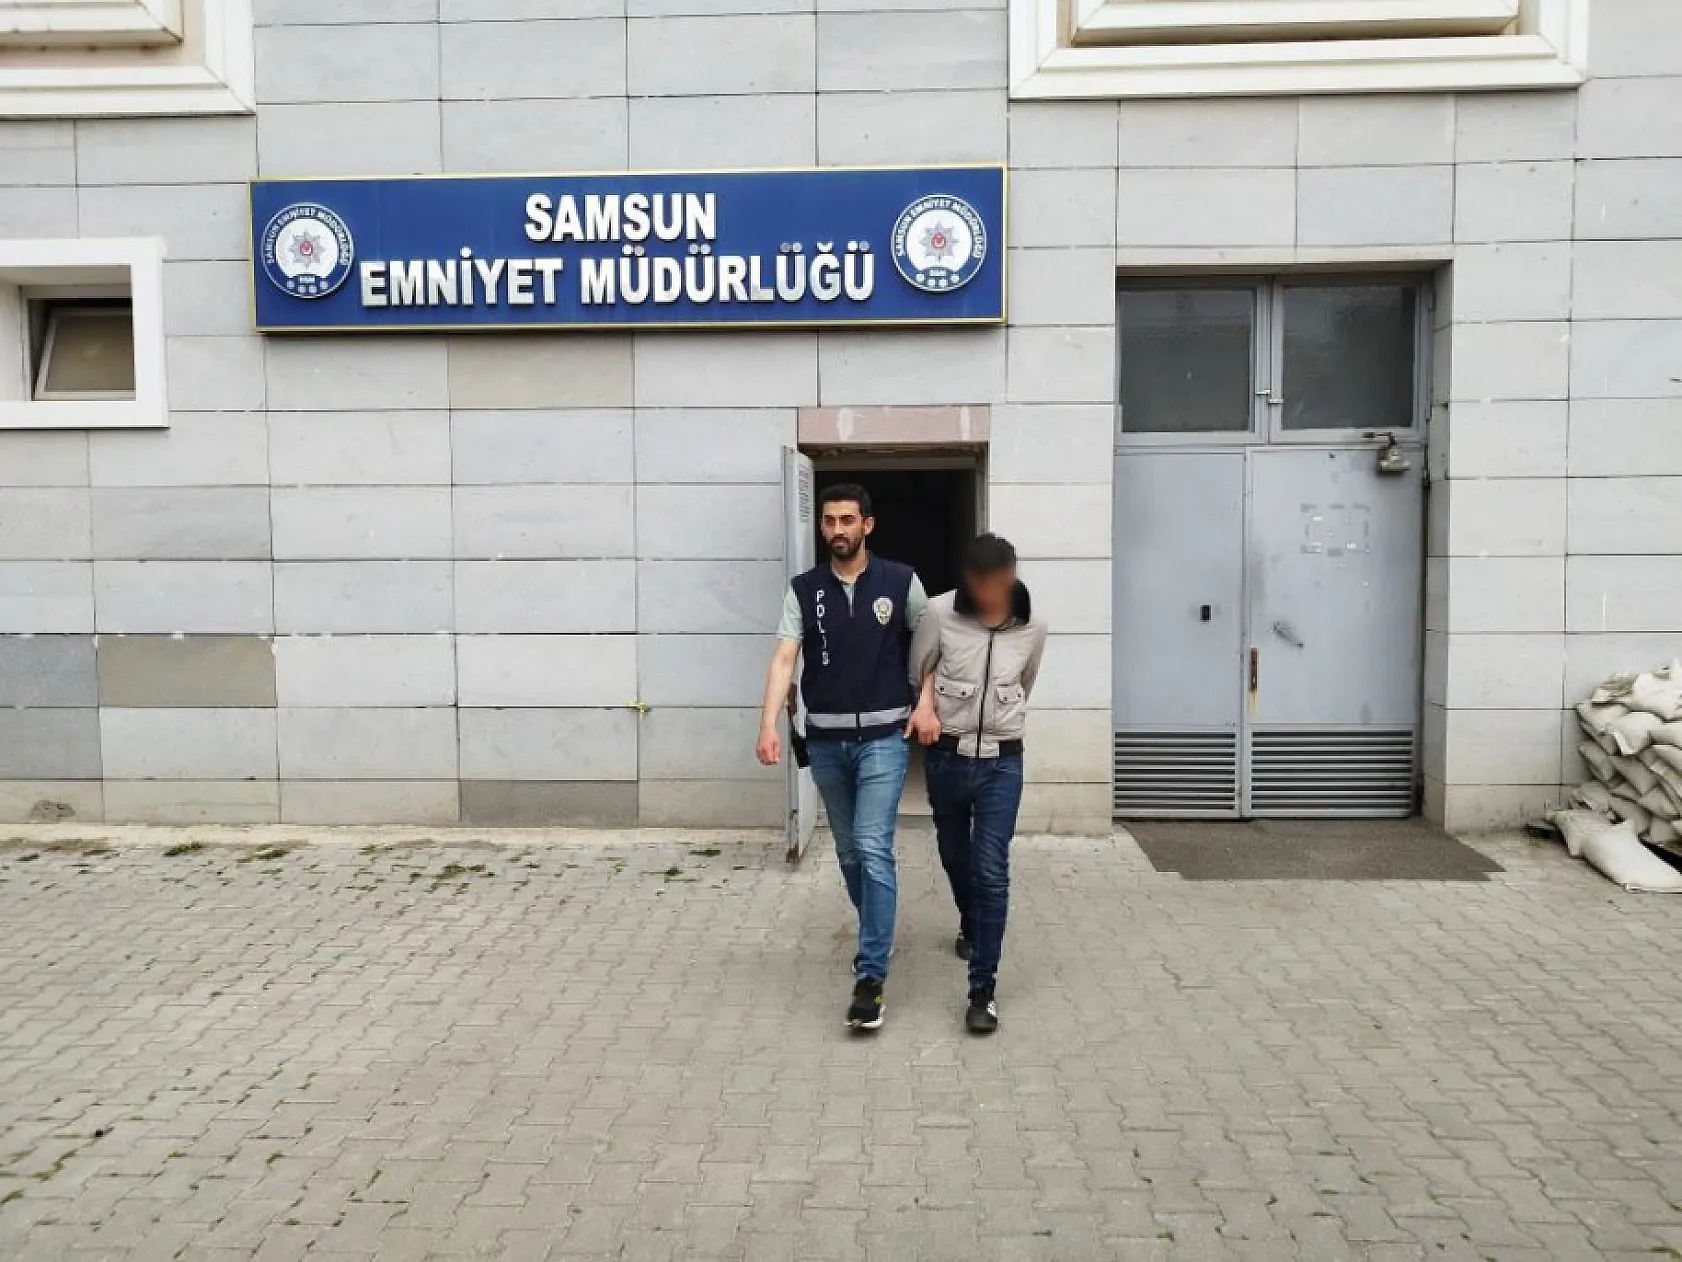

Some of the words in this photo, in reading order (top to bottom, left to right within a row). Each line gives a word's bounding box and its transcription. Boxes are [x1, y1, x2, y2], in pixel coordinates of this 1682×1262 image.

[524, 193, 716, 241] SAMSUN
[360, 247, 563, 305] EMNİYET
[580, 241, 874, 304] MÜDÜRLÜĞÜ
